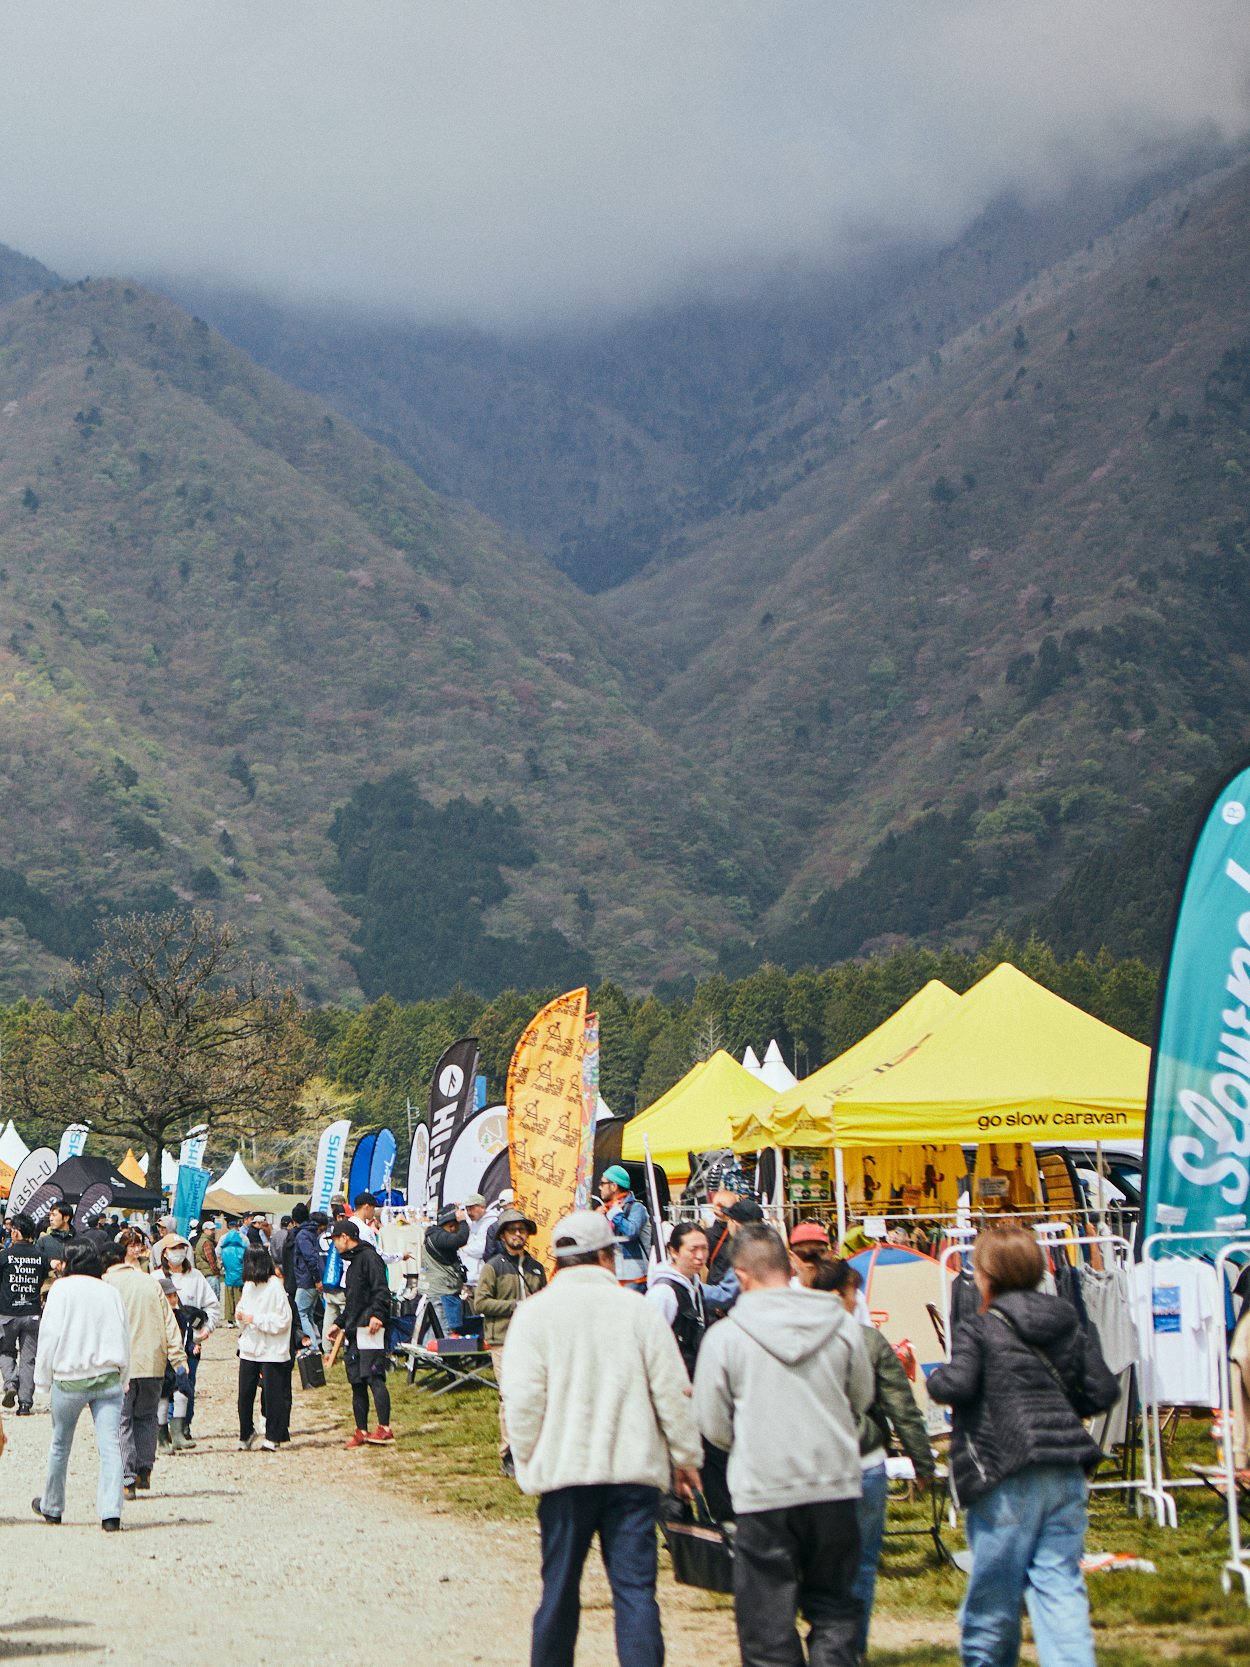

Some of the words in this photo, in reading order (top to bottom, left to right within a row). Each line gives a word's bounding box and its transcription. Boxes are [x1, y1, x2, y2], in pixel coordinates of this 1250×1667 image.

[977, 1115, 1001, 1130] go
[1005, 1112, 1049, 1126] slow
[1053, 1112, 1128, 1125] caravan
[10, 1160, 52, 1215] wash-U
[7, 1255, 42, 1267] Expand
[14, 1264, 36, 1274] Your
[9, 1274, 39, 1284] Ethical
[10, 1284, 36, 1293] Circle
